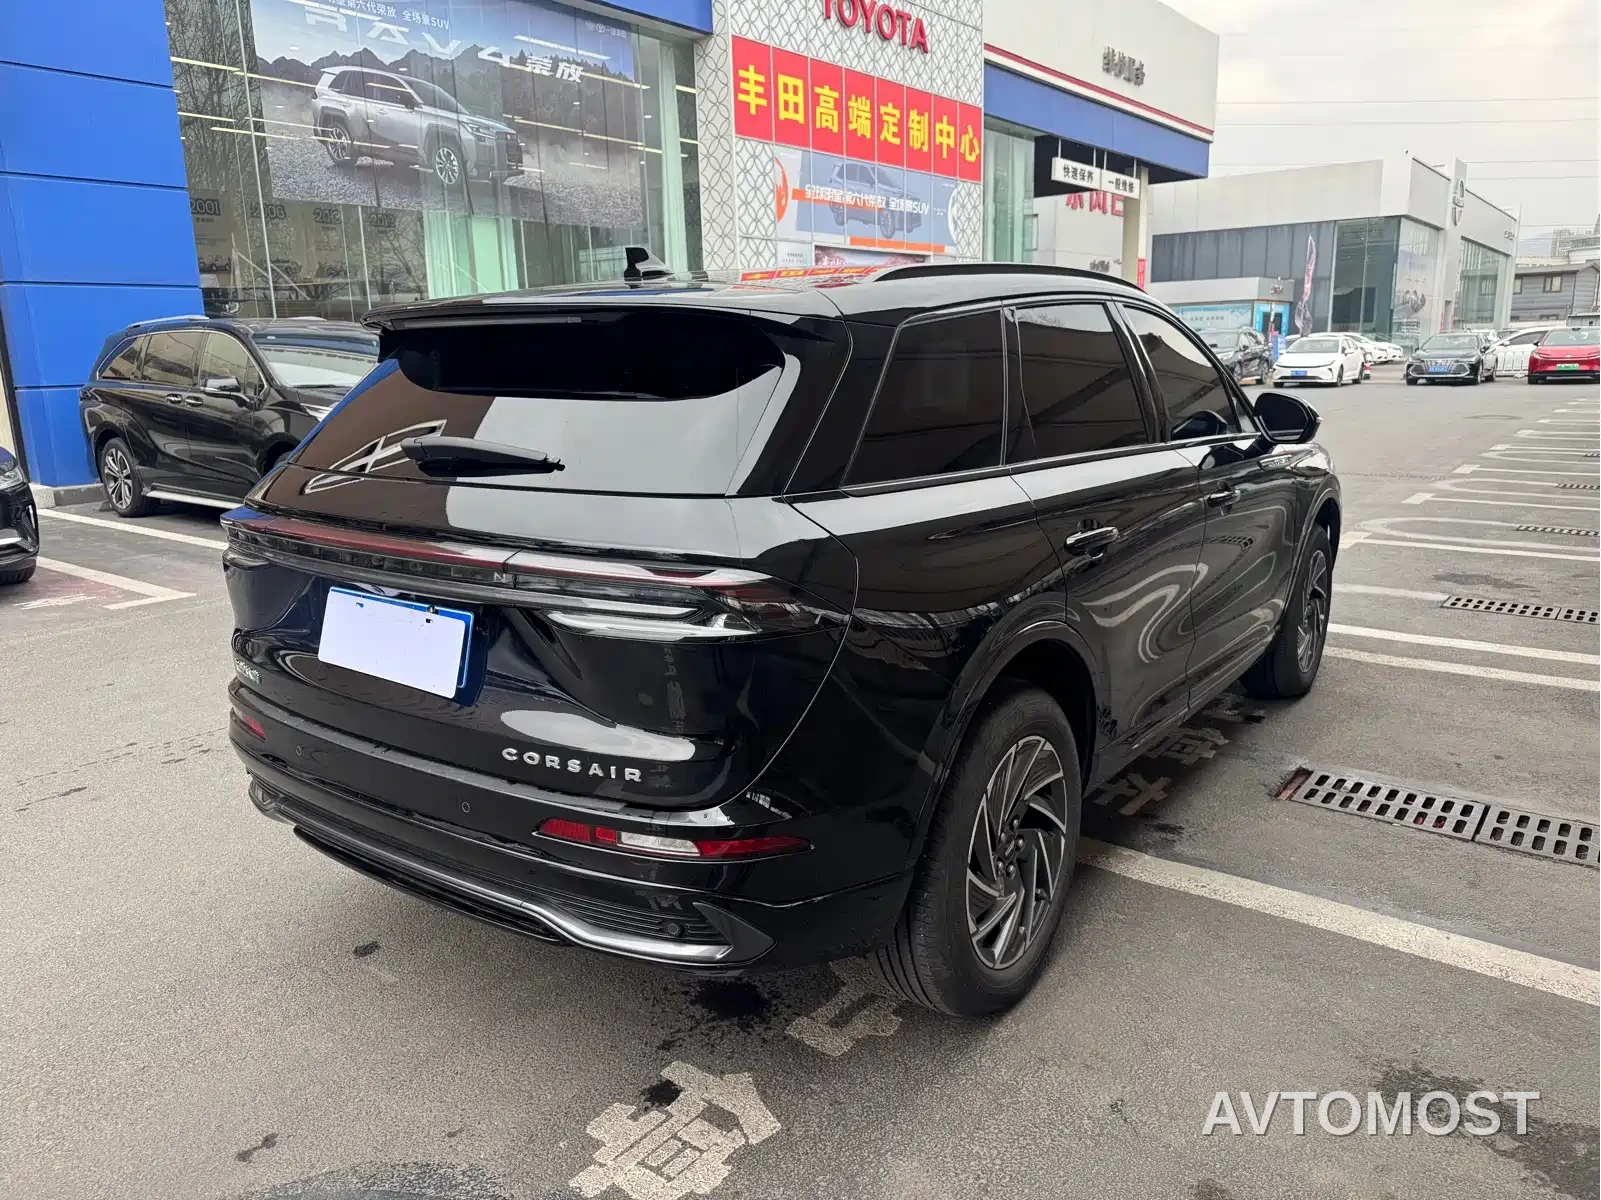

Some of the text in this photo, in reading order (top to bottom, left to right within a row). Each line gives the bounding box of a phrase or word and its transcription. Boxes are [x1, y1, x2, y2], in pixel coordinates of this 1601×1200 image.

[402, 10, 451, 30] 全场景SUV
[737, 64, 980, 163] 丰田高端定制中心
[1063, 164, 1094, 183] 快速保养
[1108, 177, 1134, 193] 一般维修
[501, 747, 643, 782] CORSAIR
